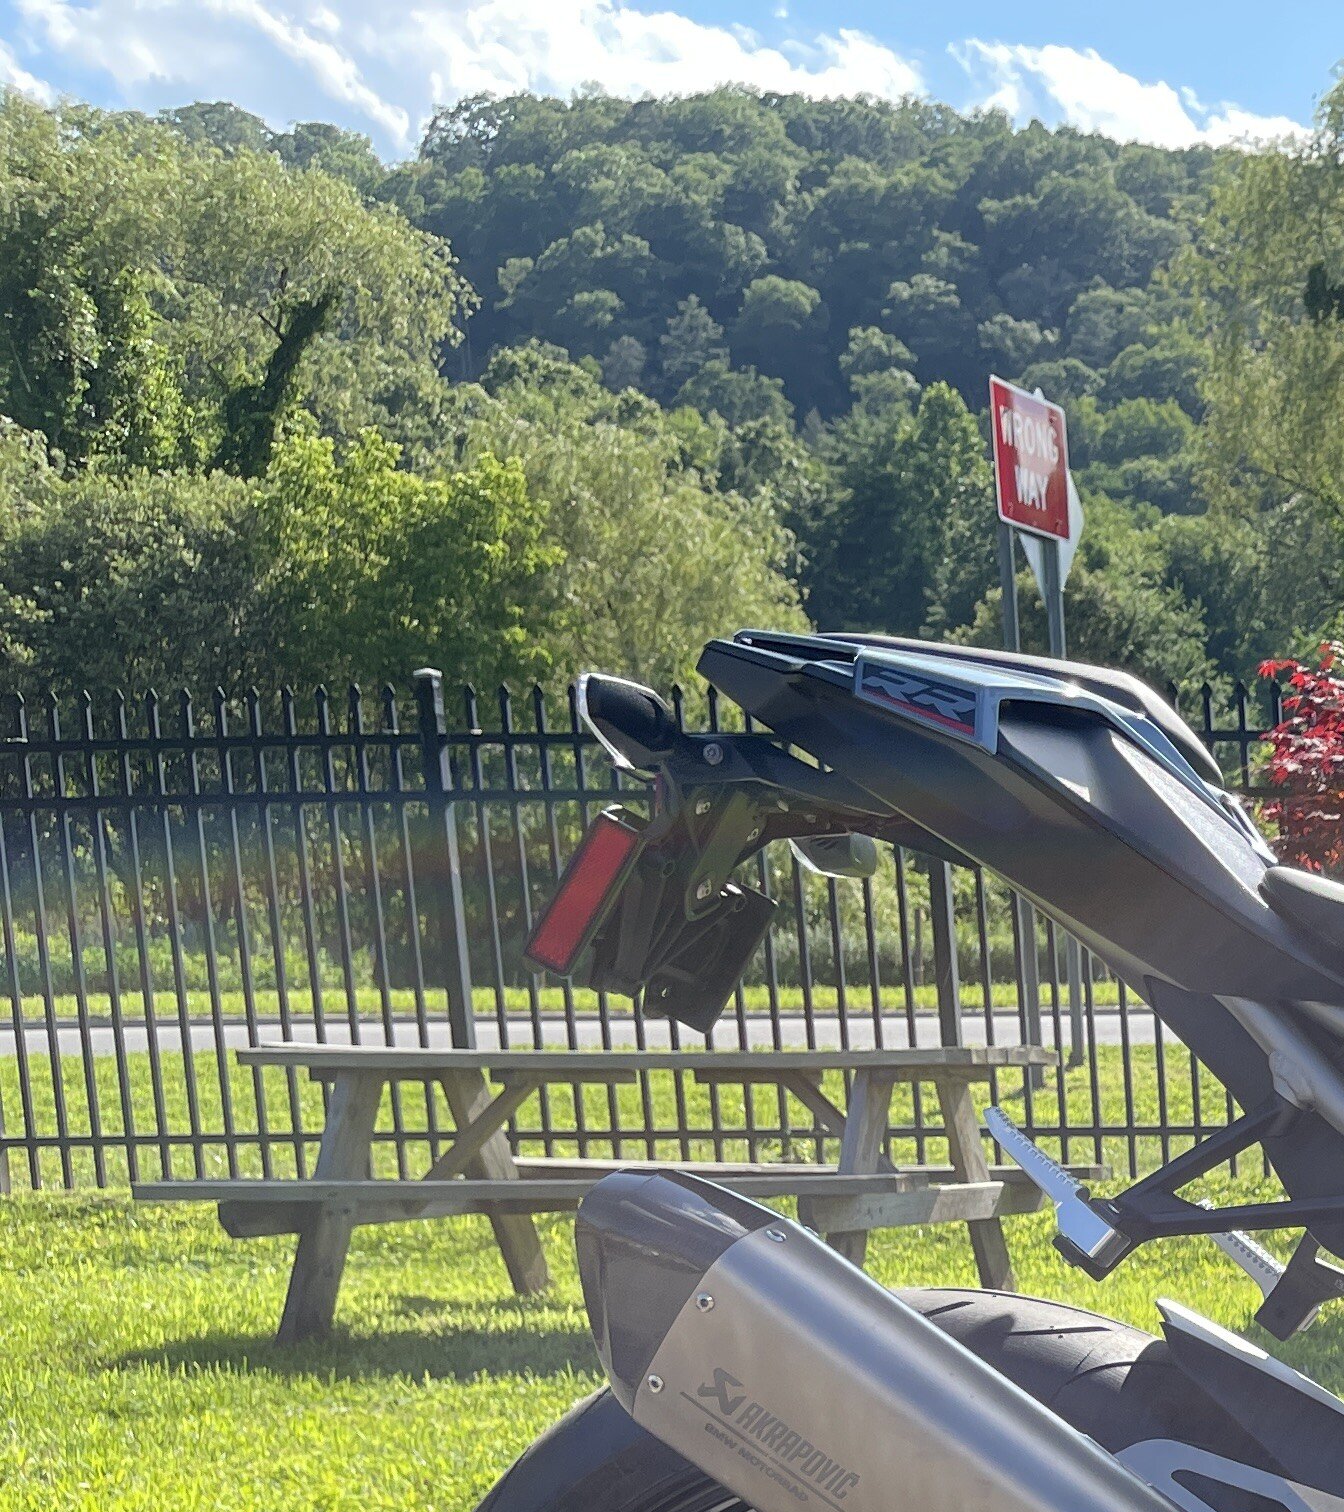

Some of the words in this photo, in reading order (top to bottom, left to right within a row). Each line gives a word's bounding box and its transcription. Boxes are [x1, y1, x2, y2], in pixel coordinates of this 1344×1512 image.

[999, 405, 1058, 464] WRONG
[1014, 465, 1049, 512] WAY
[862, 670, 977, 721] RR
[704, 1422, 738, 1449] BMW
[738, 1447, 809, 1501] MOTORRAD
